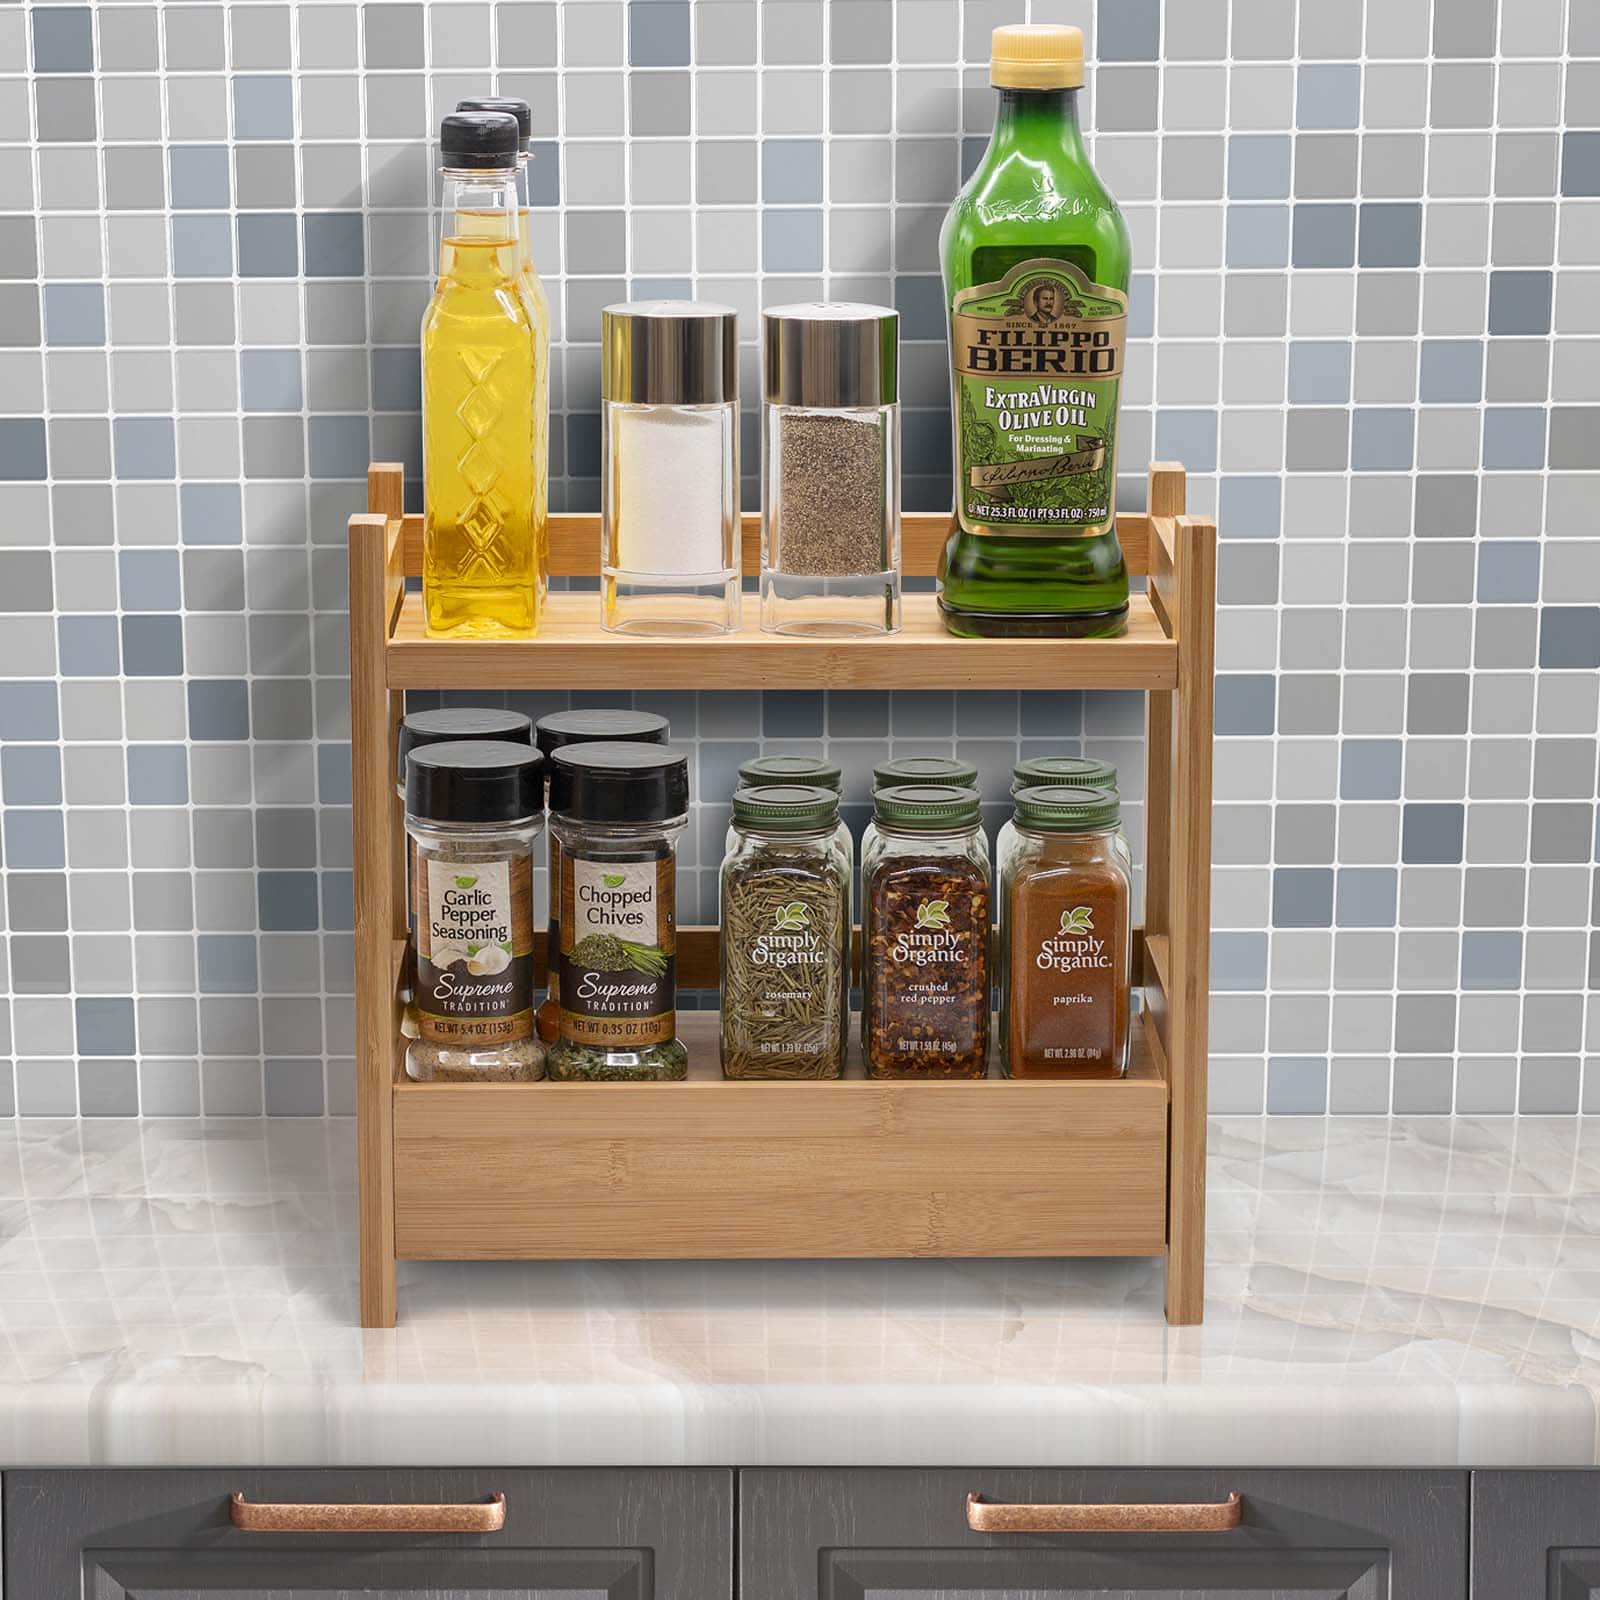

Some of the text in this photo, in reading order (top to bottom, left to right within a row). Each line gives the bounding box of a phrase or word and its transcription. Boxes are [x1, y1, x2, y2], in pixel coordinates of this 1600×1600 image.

[977, 329, 1110, 348] FILIPPO
[967, 345, 1115, 374] BERIO
[998, 406, 1088, 431] OLIVE OIL
[1008, 434, 1071, 445] For Dressing &
[1016, 444, 1064, 455] Marinating
[976, 504, 989, 517] NET
[991, 506, 1007, 517] 25.3
[1008, 507, 1017, 518] FL
[1018, 507, 1028, 518] OZ
[1029, 507, 1036, 519] (1
[1037, 508, 1047, 519] PT
[1048, 508, 1060, 519] 9.3
[1061, 508, 1070, 519] FL
[1071, 508, 1084, 520] OZ)
[444, 889, 492, 906] Garlic
[579, 885, 652, 909] Chopped
[441, 905, 496, 927] Pepper
[587, 906, 644, 925] Chives
[432, 922, 508, 943] Seasoning
[897, 929, 961, 951] Simply
[757, 931, 820, 953] Simply
[1041, 935, 1105, 957] Simply
[433, 973, 514, 1002] Supreme
[576, 972, 657, 1002] Supreme
[765, 990, 813, 1001] rosemary
[908, 981, 949, 993] crushed
[442, 1000, 507, 1012] TRADITION
[586, 999, 650, 1012] TRADITION
[901, 992, 956, 1006] red pepper
[1052, 993, 1093, 1006] paprika
[434, 1021, 445, 1033] NET
[461, 1023, 473, 1035] 5.4
[475, 1023, 487, 1035] OZ
[573, 1019, 661, 1036] NET WT 0.35 OZ (10g)
